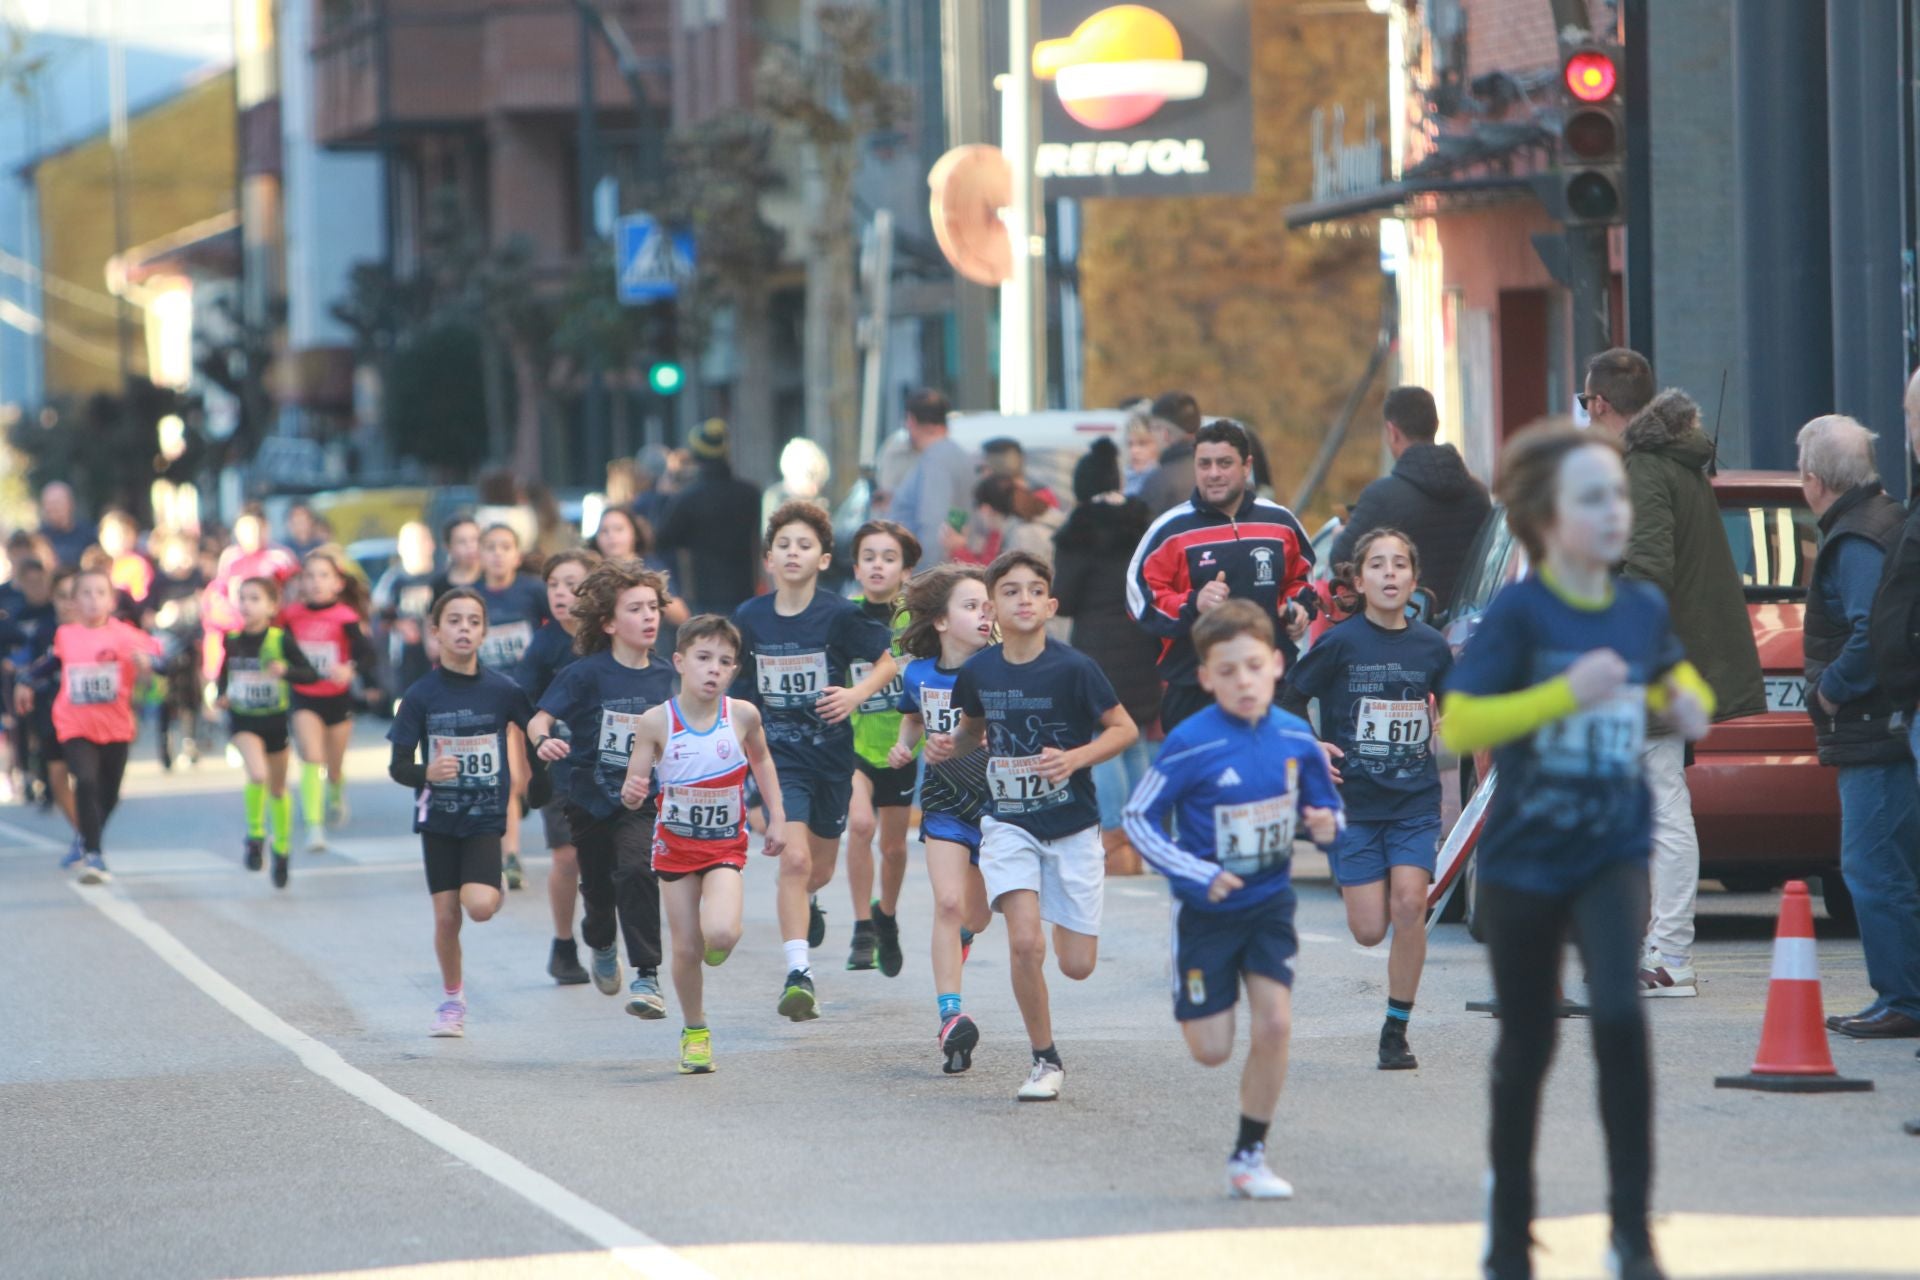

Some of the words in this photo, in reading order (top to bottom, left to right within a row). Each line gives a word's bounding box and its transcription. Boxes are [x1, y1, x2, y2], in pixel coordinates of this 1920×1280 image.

[1035, 138, 1210, 177] REPSOL
[1356, 664, 1386, 672] diciembre
[1387, 662, 1402, 671] 2024
[780, 671, 816, 694] 497
[1348, 683, 1384, 693] LLANERA
[1371, 702, 1388, 710] SAN
[1388, 719, 1423, 743] 617
[689, 805, 729, 827] 675
[1254, 818, 1289, 852] 737
